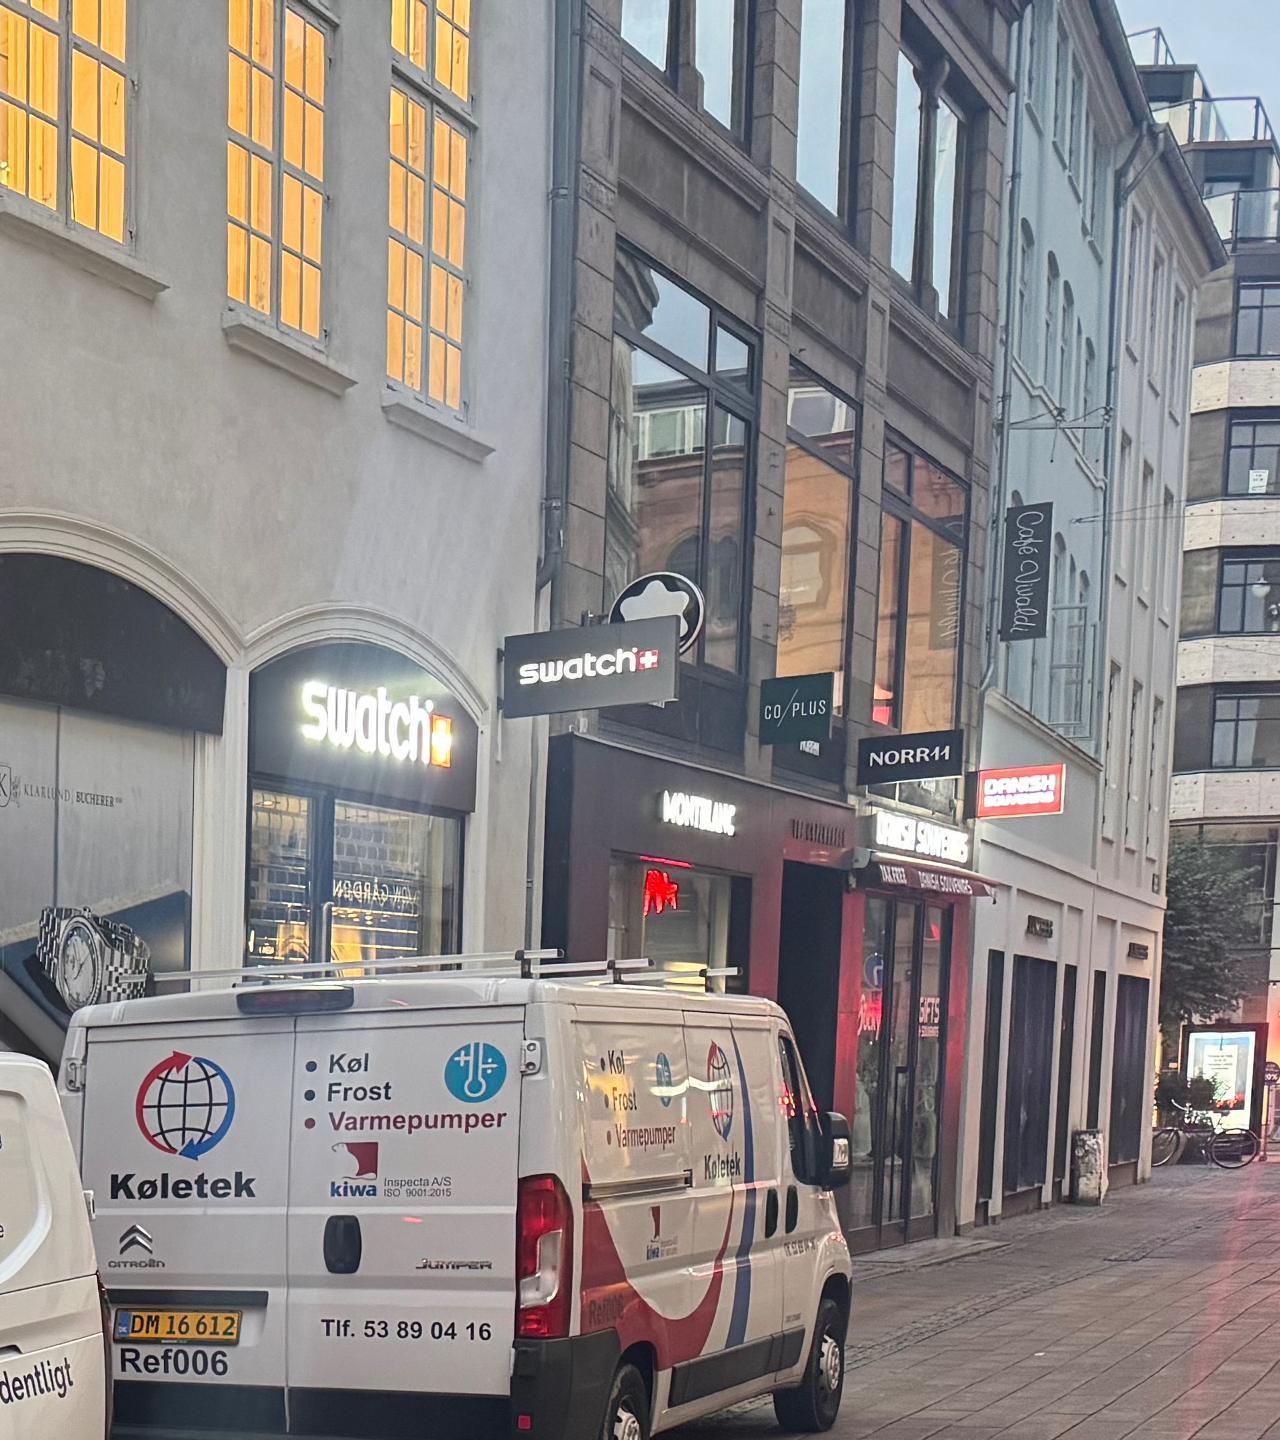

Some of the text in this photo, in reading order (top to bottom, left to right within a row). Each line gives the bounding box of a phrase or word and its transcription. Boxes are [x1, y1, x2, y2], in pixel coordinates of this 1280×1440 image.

[1010, 511, 1044, 633] Café Vivaldi
[519, 647, 637, 685] swatch
[301, 680, 433, 765] swatch
[869, 746, 950, 767] NORR11
[984, 775, 1055, 795] DANISH
[329, 1053, 369, 1074] Køl
[608, 1050, 624, 1074] Køl
[328, 1081, 392, 1102] Frost
[612, 1090, 637, 1111] Frost
[329, 1110, 507, 1134] Varmepumper
[615, 1123, 676, 1151] Varmepumper
[704, 1152, 740, 1181] Køletek
[110, 1171, 256, 1200] Køletek
[330, 1181, 377, 1197] kiwa
[384, 1177, 451, 1189] Inspecta A/S
[384, 1189, 451, 1197] ISO 9001:2015
[131, 1315, 159, 1334] DM
[166, 1316, 189, 1335] 16
[196, 1315, 236, 1336] 612
[321, 1319, 491, 1341] Tlf. 53 89 04 16
[120, 1347, 228, 1376] Ref006
